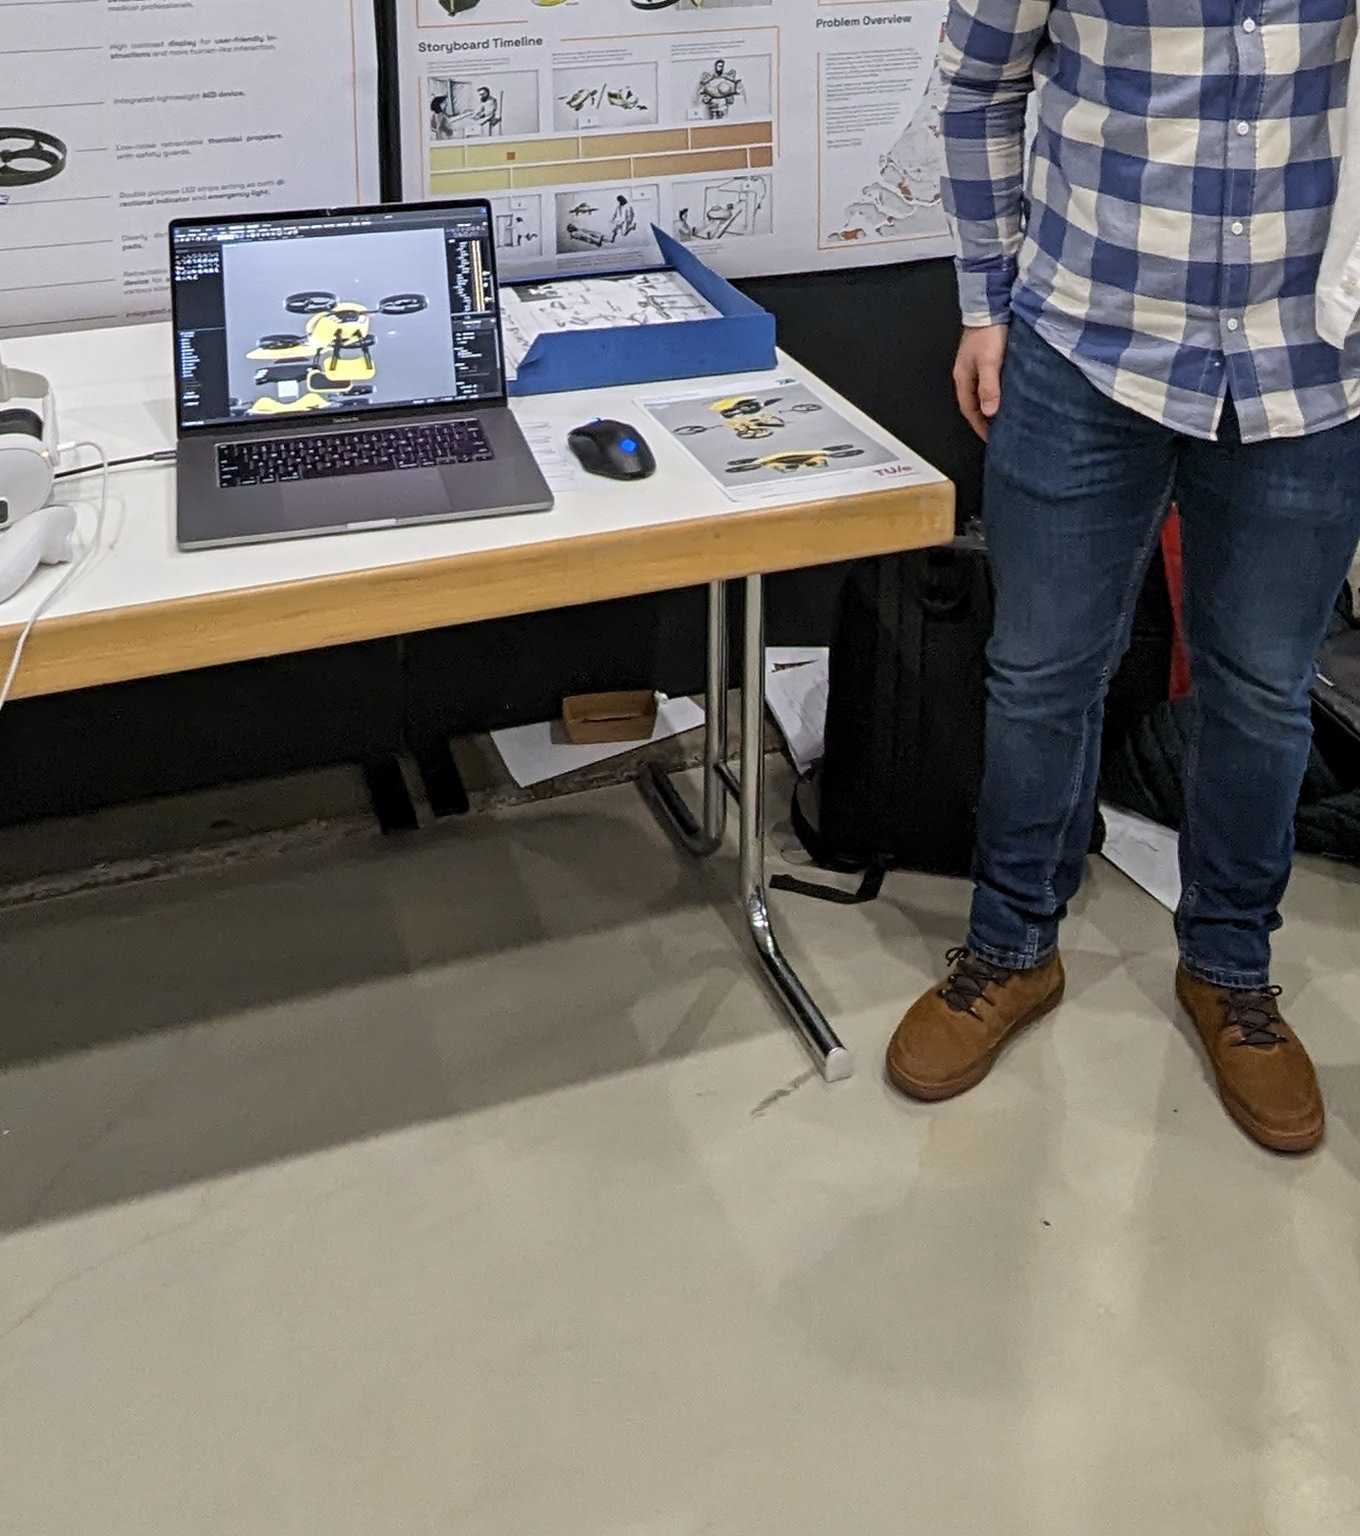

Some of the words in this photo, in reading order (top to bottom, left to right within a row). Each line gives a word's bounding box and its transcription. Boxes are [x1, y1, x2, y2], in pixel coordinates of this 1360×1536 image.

[815, 17, 860, 29] Problem
[862, 14, 912, 26] Overview
[417, 38, 491, 54] Storyboard
[492, 35, 544, 50] Timeline
